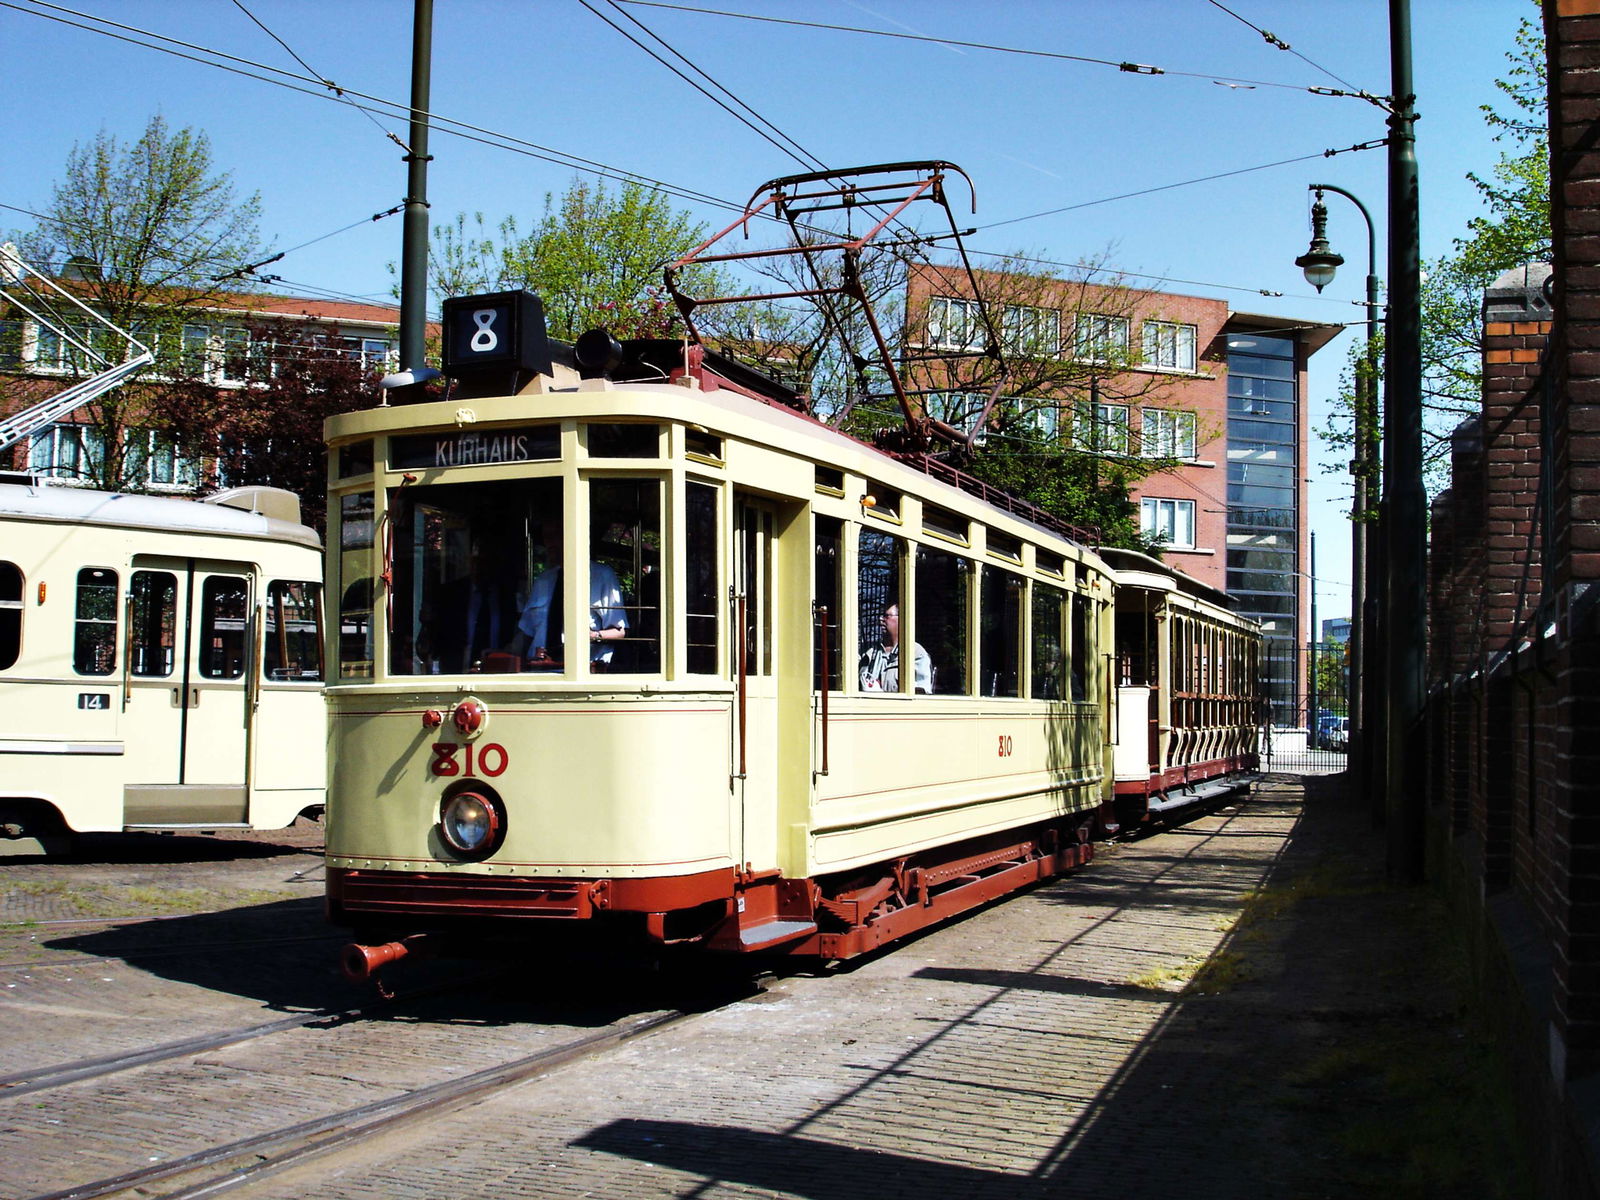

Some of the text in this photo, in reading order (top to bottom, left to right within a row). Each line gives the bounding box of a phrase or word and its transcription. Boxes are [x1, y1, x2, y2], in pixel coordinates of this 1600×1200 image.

[471, 308, 497, 352] 8
[436, 436, 528, 466] KURHAUS
[83, 695, 102, 709] 14
[432, 743, 508, 778] 810
[998, 735, 1013, 757] 810
